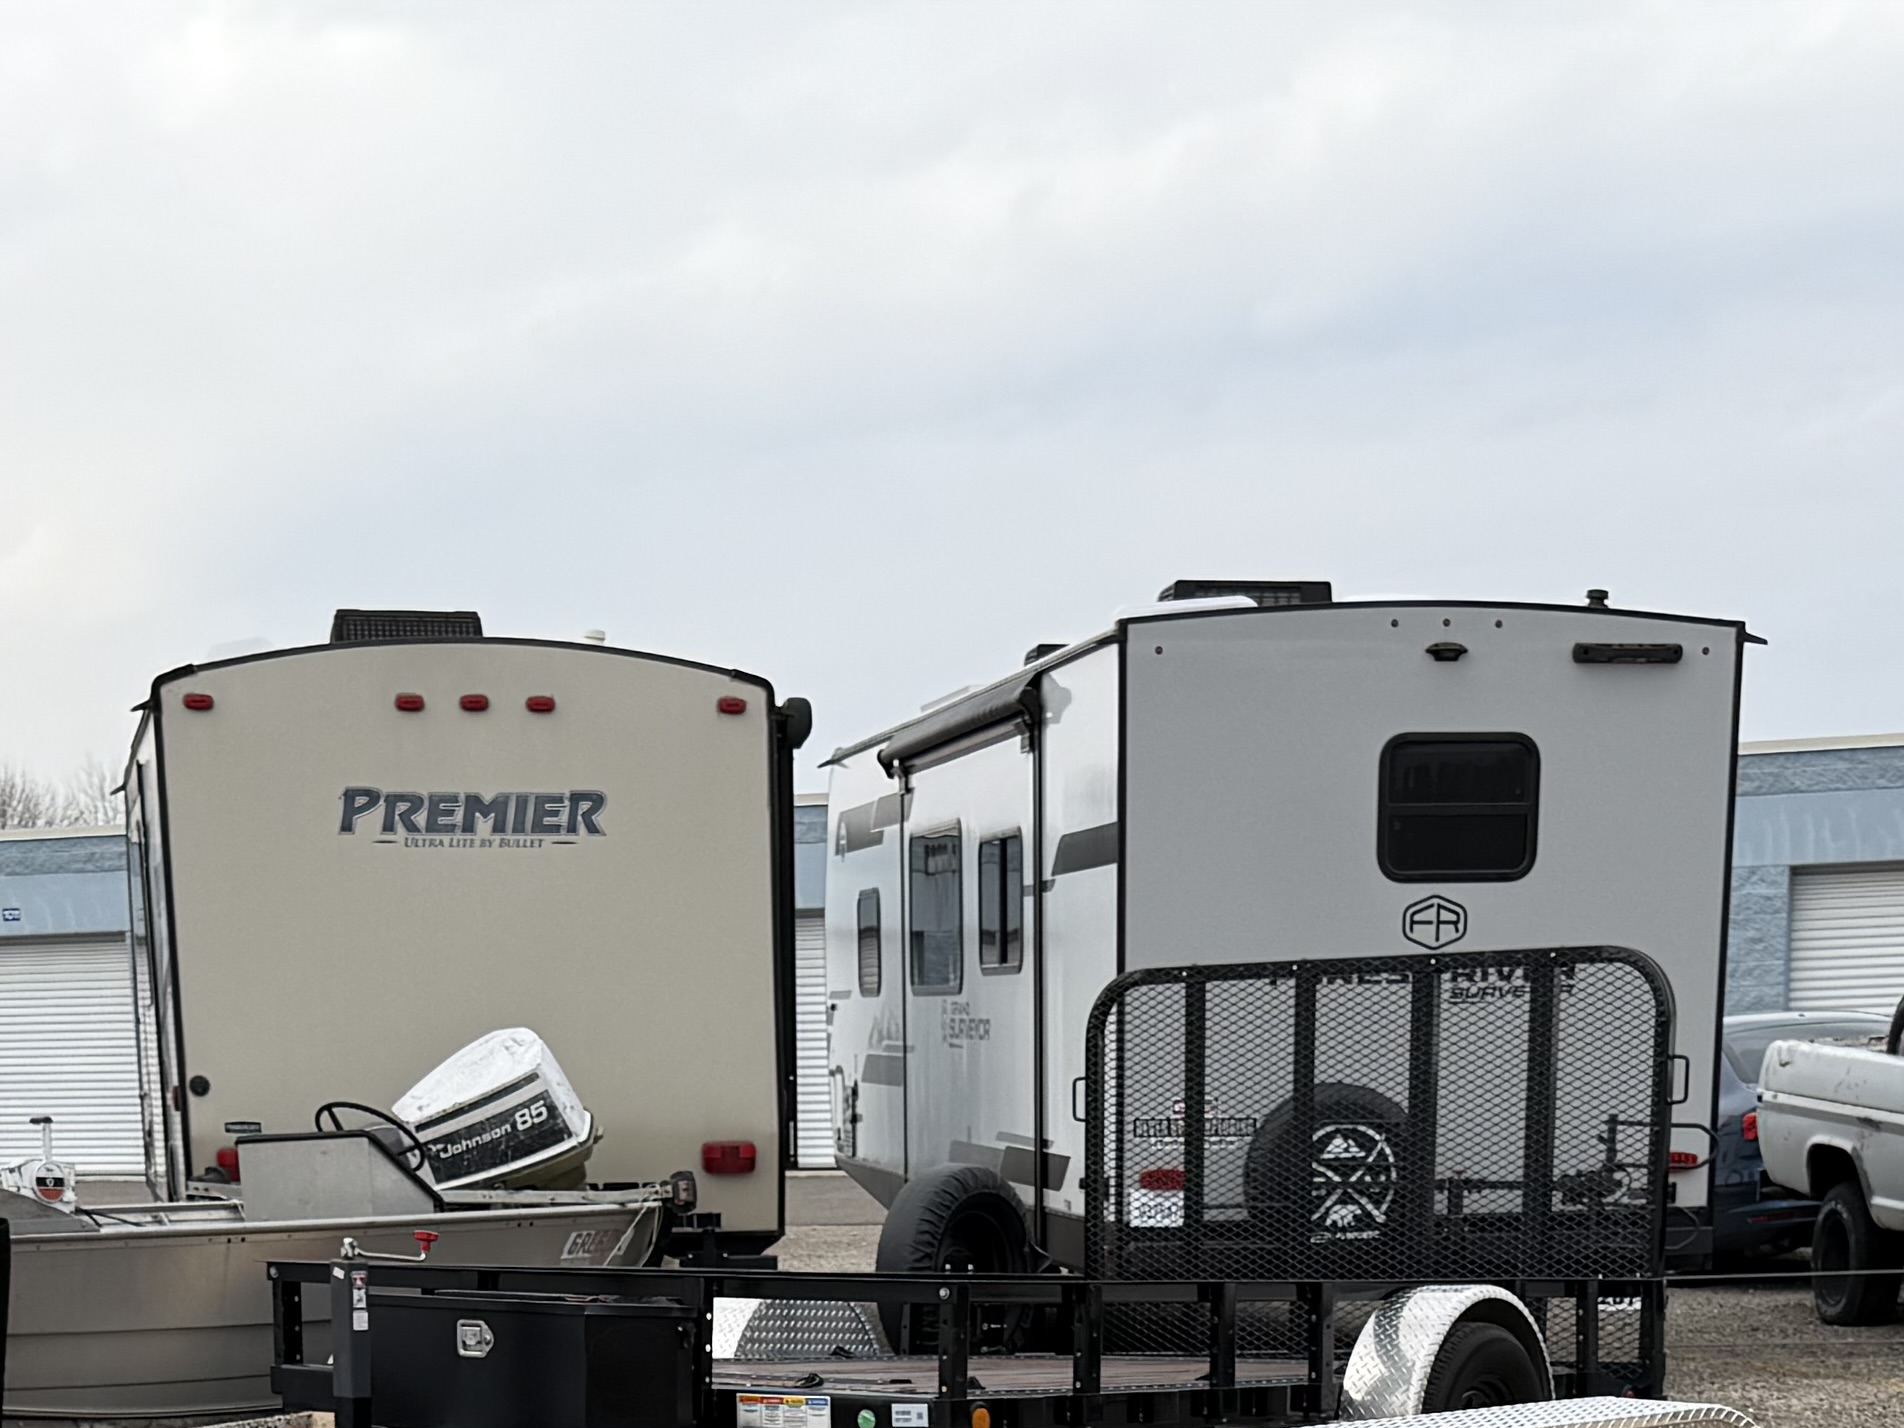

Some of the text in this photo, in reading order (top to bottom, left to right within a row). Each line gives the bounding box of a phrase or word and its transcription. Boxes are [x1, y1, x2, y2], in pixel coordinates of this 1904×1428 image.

[338, 786, 607, 836] PREMIER
[439, 1100, 548, 1159] Johnson 85
